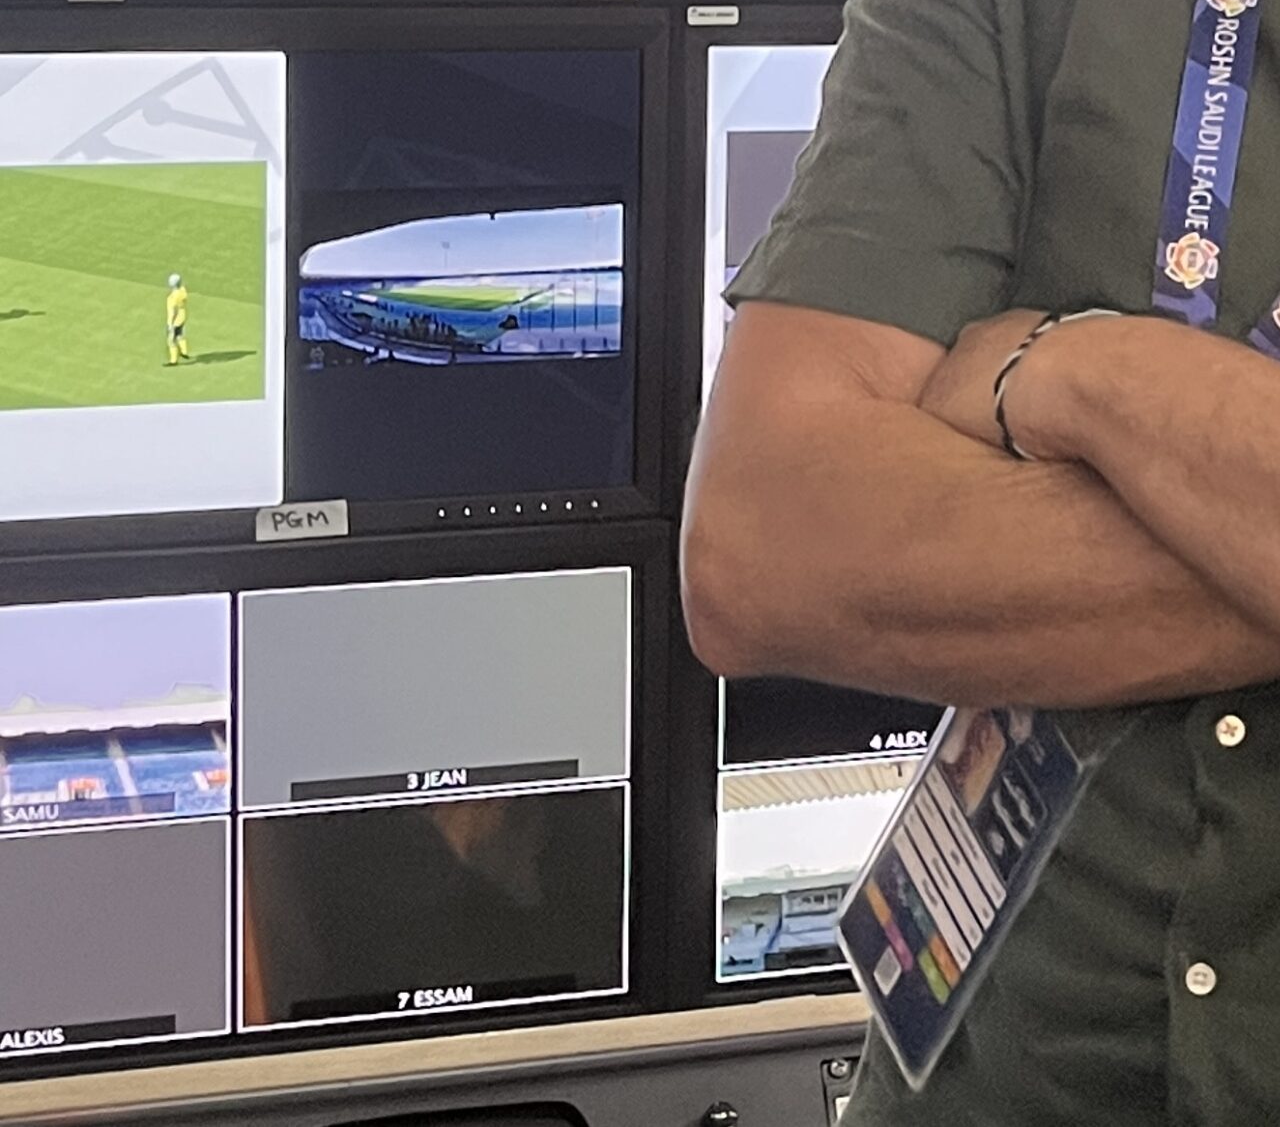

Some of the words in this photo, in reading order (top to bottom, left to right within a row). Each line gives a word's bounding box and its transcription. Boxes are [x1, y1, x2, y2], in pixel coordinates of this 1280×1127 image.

[1207, 18, 1240, 87] ROSHN
[1196, 89, 1228, 151] SAUDI
[1184, 153, 1219, 231] LEAGUE
[271, 510, 330, 532] PGM
[884, 730, 928, 750] ALEX
[407, 773, 419, 790] 3
[421, 768, 468, 792] JEAN
[3, 805, 60, 824] SAMU
[398, 992, 411, 1010] 7
[414, 985, 473, 1008] ESSAM
[1, 1027, 66, 1050] ALEXIS
